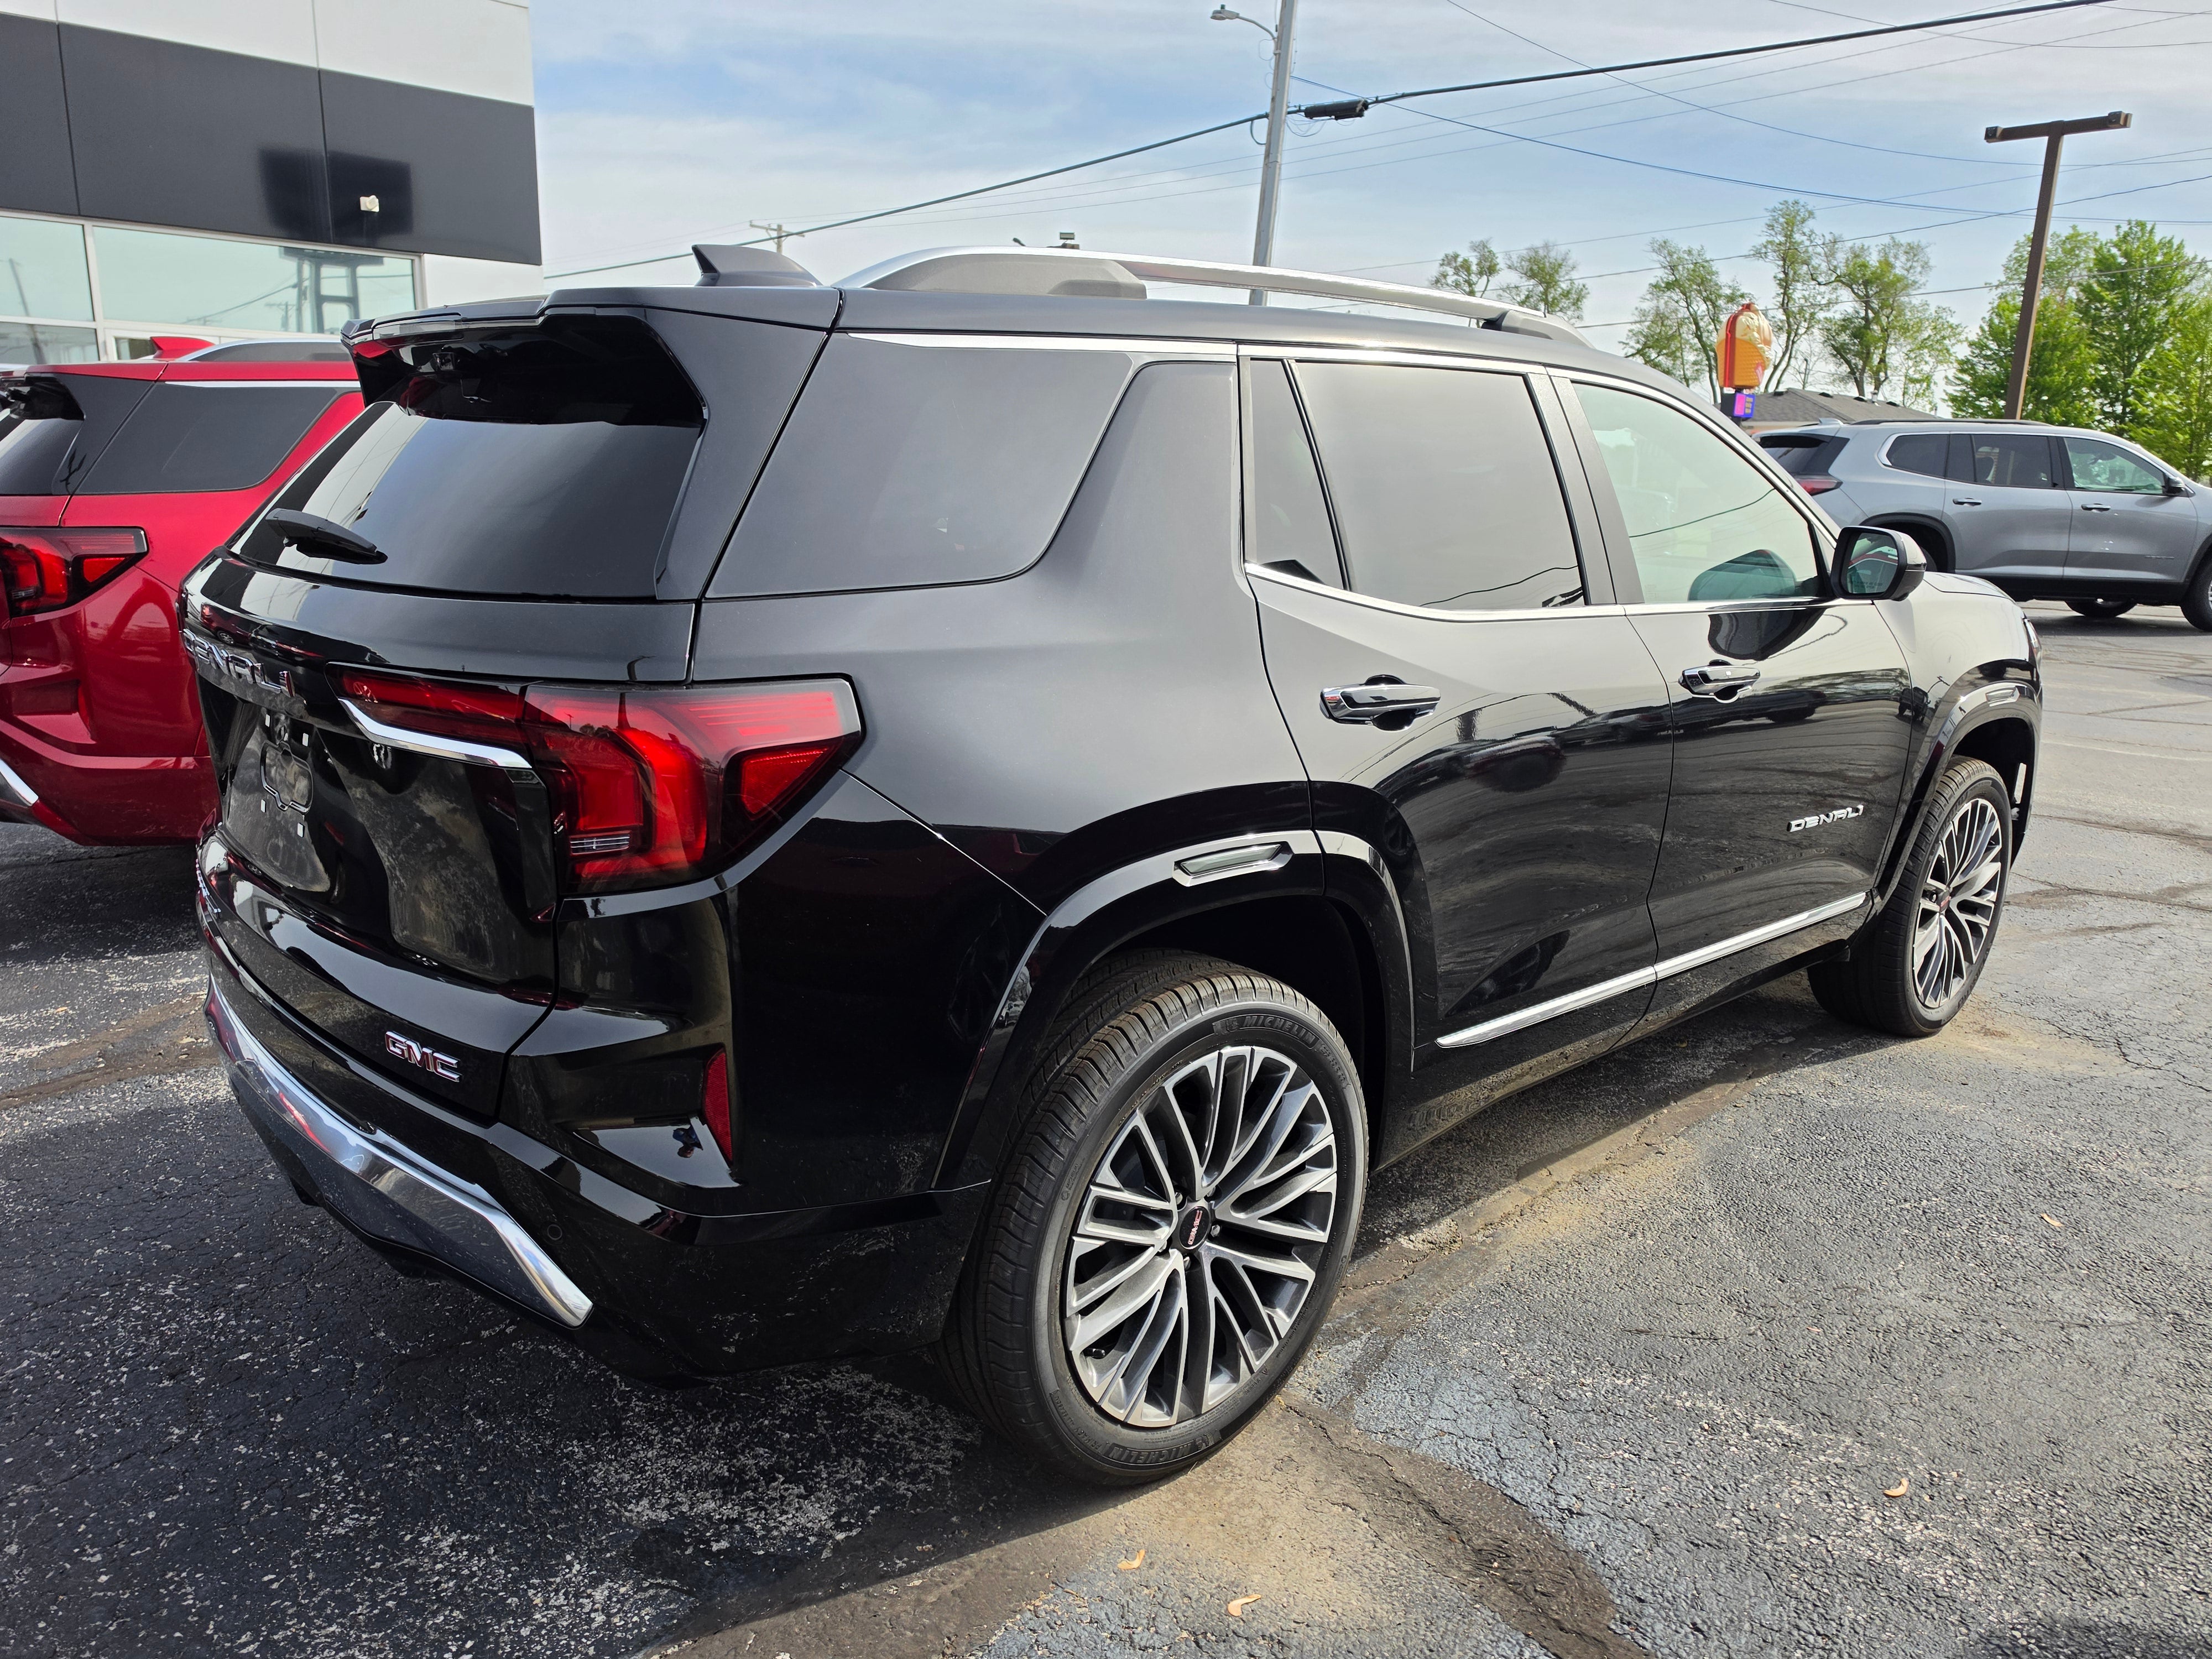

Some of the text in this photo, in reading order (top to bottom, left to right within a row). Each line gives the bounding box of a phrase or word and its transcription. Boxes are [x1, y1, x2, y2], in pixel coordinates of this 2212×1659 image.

[183, 628, 295, 697] DENALI
[1787, 804, 1864, 832] DENALI
[1243, 1015, 1316, 1044] MICHELIN
[385, 1031, 460, 1082] GMC
[1188, 1210, 1203, 1245] GMC
[1108, 1443, 1192, 1464] MICHELIN
